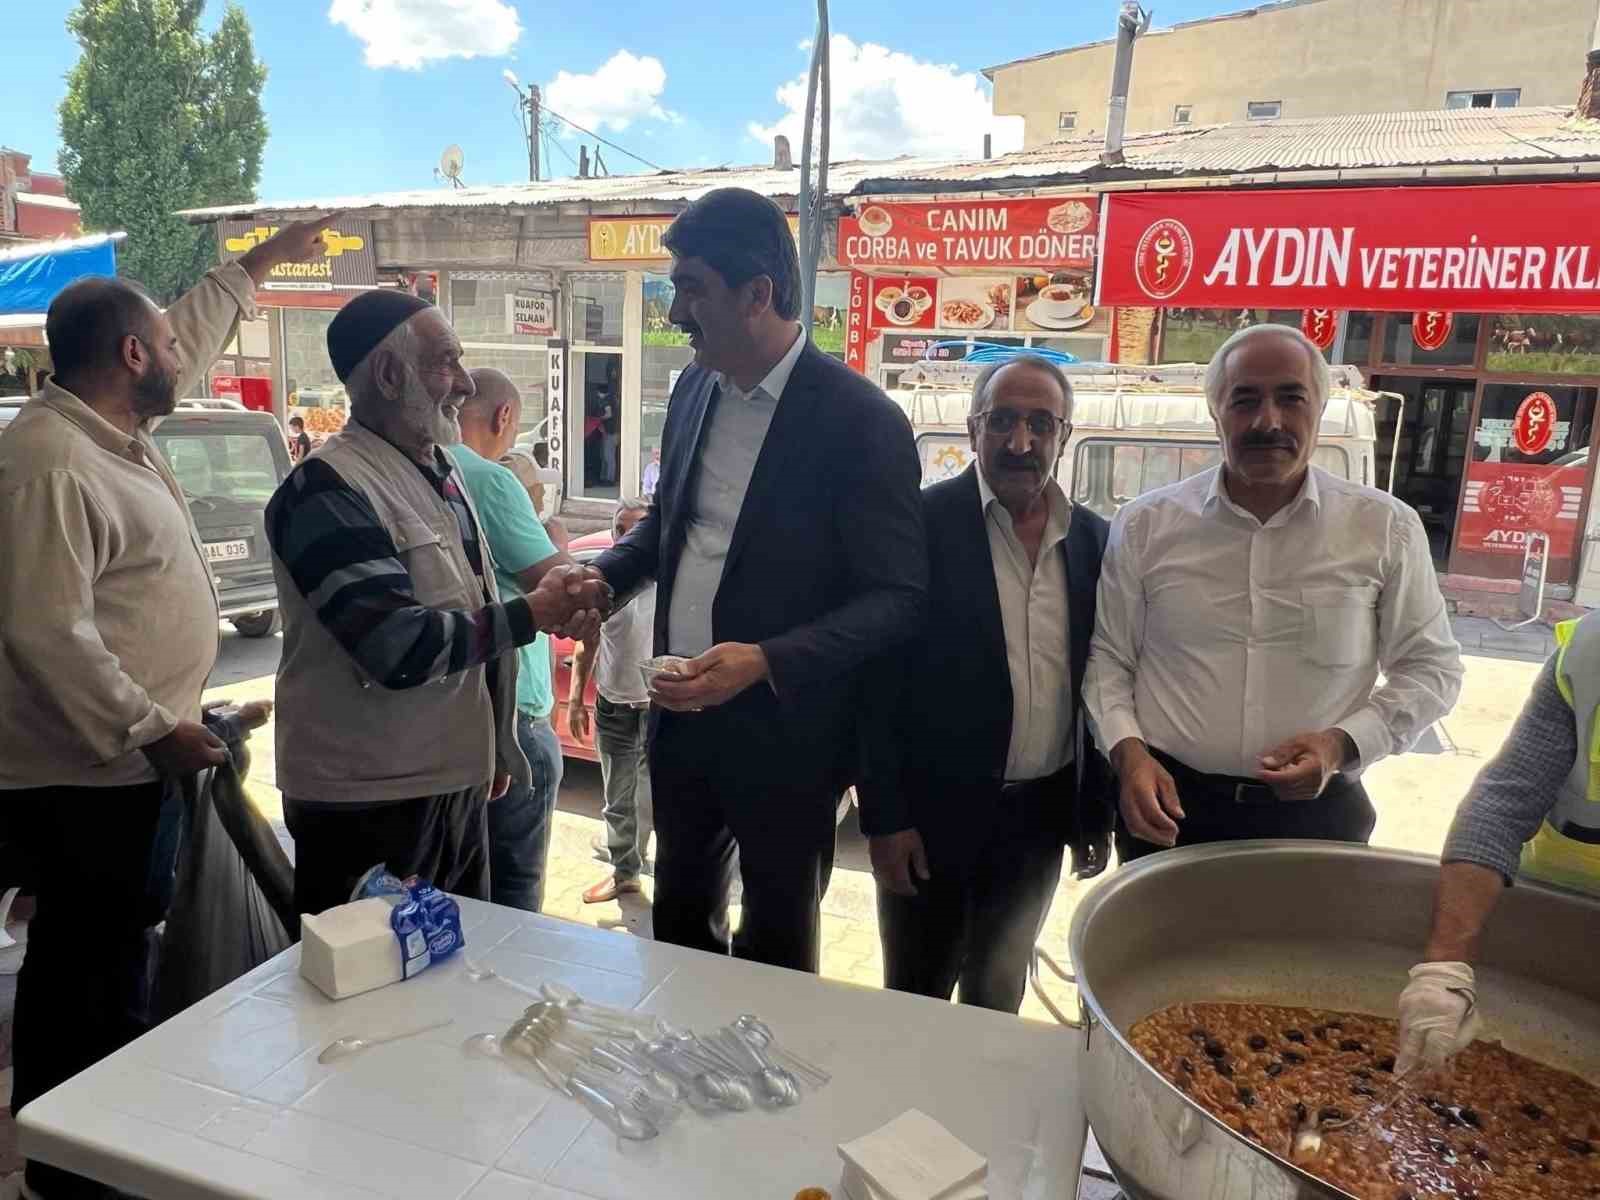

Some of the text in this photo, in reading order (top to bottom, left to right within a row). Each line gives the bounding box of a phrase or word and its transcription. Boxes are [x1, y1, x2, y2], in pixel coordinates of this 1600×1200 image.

[928, 207, 1008, 231] CANIM
[846, 228, 1096, 265] ÇORBA ve TAVUK DÖNER
[1203, 227, 1356, 286] AYDIN
[1359, 234, 1547, 289] VETERİNER
[1550, 246, 1600, 289] KL
[848, 276, 862, 361] ÇORBA
